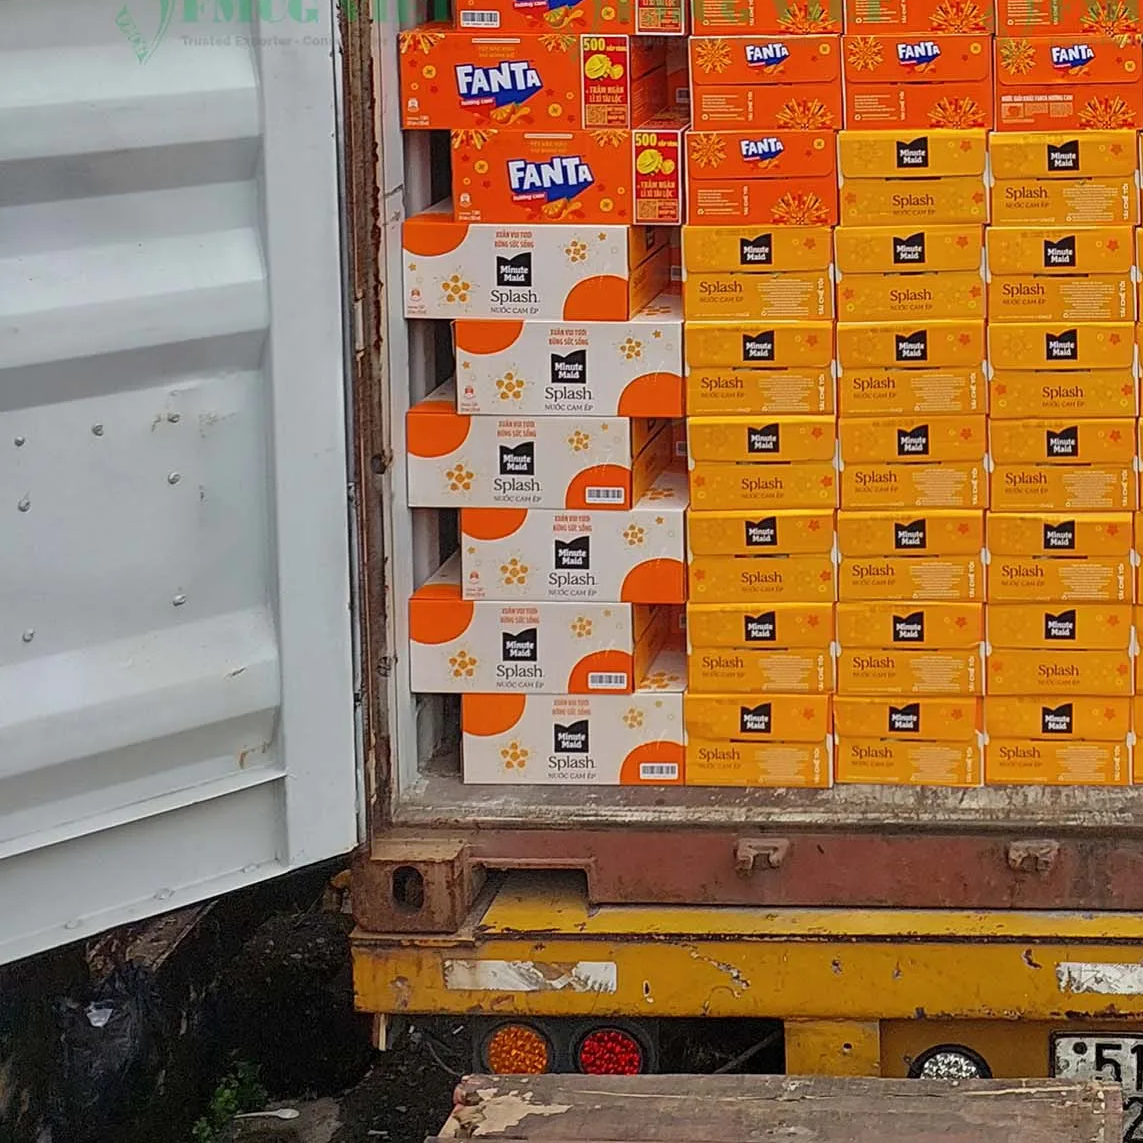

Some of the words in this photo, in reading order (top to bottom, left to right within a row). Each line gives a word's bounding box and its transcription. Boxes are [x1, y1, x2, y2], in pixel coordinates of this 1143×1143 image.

[584, 38, 606, 51] 500
[746, 43, 791, 61] FANTA
[455, 61, 543, 96] FANTA
[635, 133, 657, 147] 500
[741, 137, 786, 156] FANTA
[507, 156, 594, 191] FANTA
[891, 192, 934, 210] Splash
[500, 265, 528, 274] Minute
[490, 289, 537, 305] Splash
[888, 287, 932, 306] Splash
[554, 362, 583, 372] Minute
[558, 371, 579, 379] Maid
[544, 387, 592, 403] Splash
[503, 454, 531, 463] Minute
[494, 478, 540, 493] Splash
[740, 476, 783, 494] Splash
[558, 548, 586, 557] Minute
[562, 556, 582, 565] Maid
[851, 562, 894, 580] Splash
[549, 573, 595, 587] Splash
[506, 640, 534, 649] Minute
[510, 648, 530, 657] Maid
[496, 665, 543, 679] Splash
[1037, 662, 1079, 679] Splash
[558, 732, 586, 742] Minute
[561, 741, 583, 749] Maid
[548, 756, 594, 770] Splash
